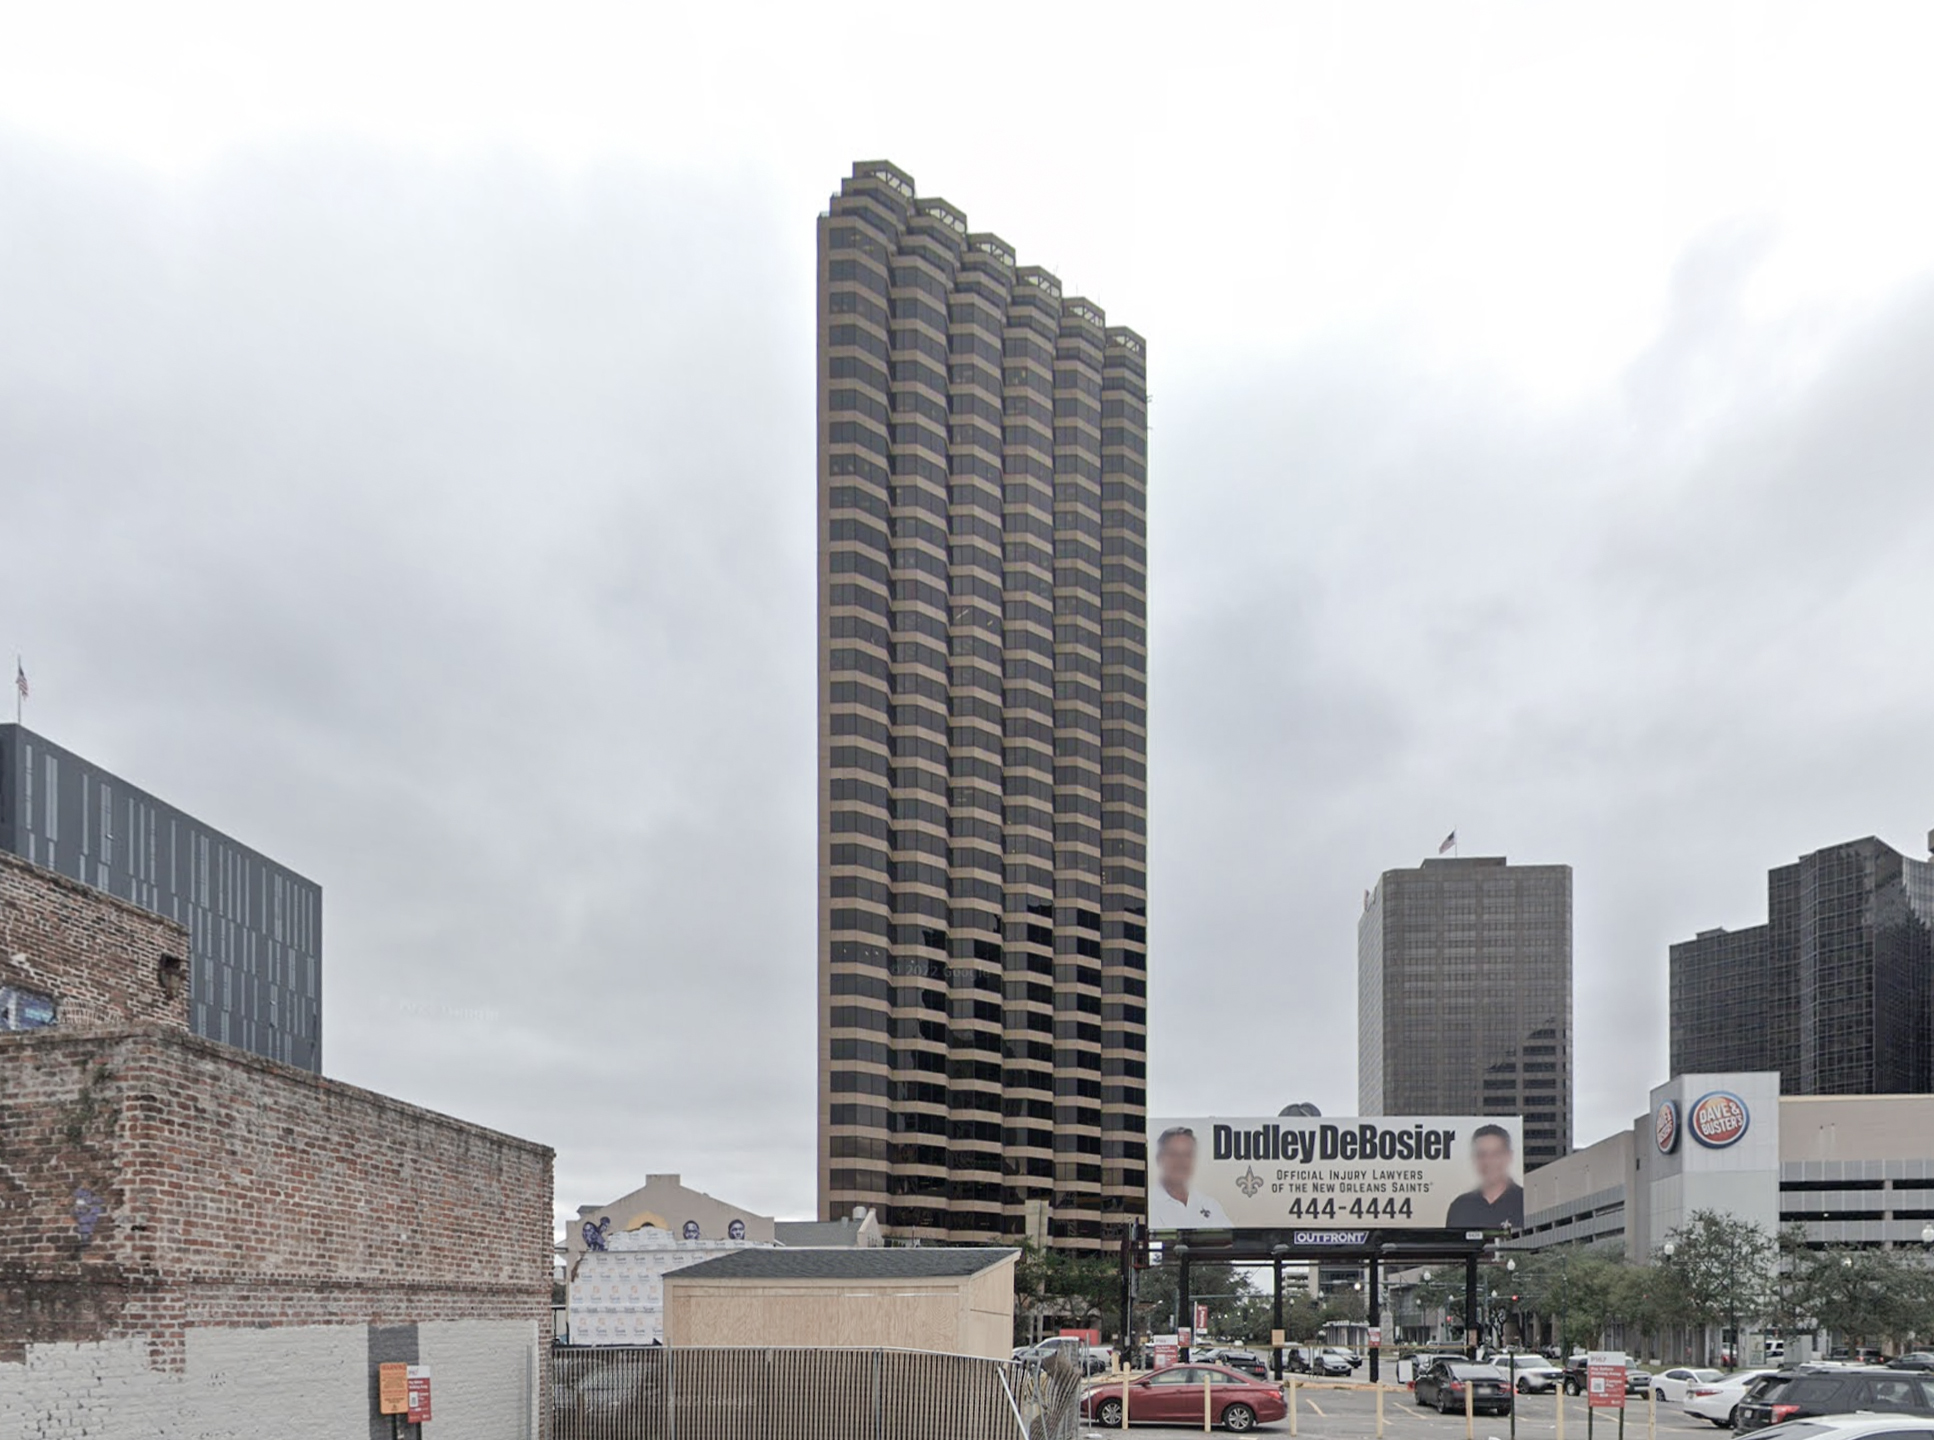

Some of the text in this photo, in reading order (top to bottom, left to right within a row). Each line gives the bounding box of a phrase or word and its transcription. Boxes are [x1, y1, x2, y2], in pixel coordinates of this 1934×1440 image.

[1699, 1101, 1740, 1122] DAVE &
[1701, 1115, 1742, 1135] BUSTER'S
[1213, 1124, 1455, 1164] Dudley DeBosier
[1276, 1169, 1423, 1180] OFFICIAL INJURY LAWYERS
[1271, 1183, 1284, 1193] OF
[1289, 1183, 1308, 1193] THE
[1312, 1182, 1335, 1193] NEW
[1339, 1182, 1387, 1193] ORLEANS
[1288, 1197, 1413, 1219] 444-4444
[1296, 1232, 1366, 1244] OUTFRONT
